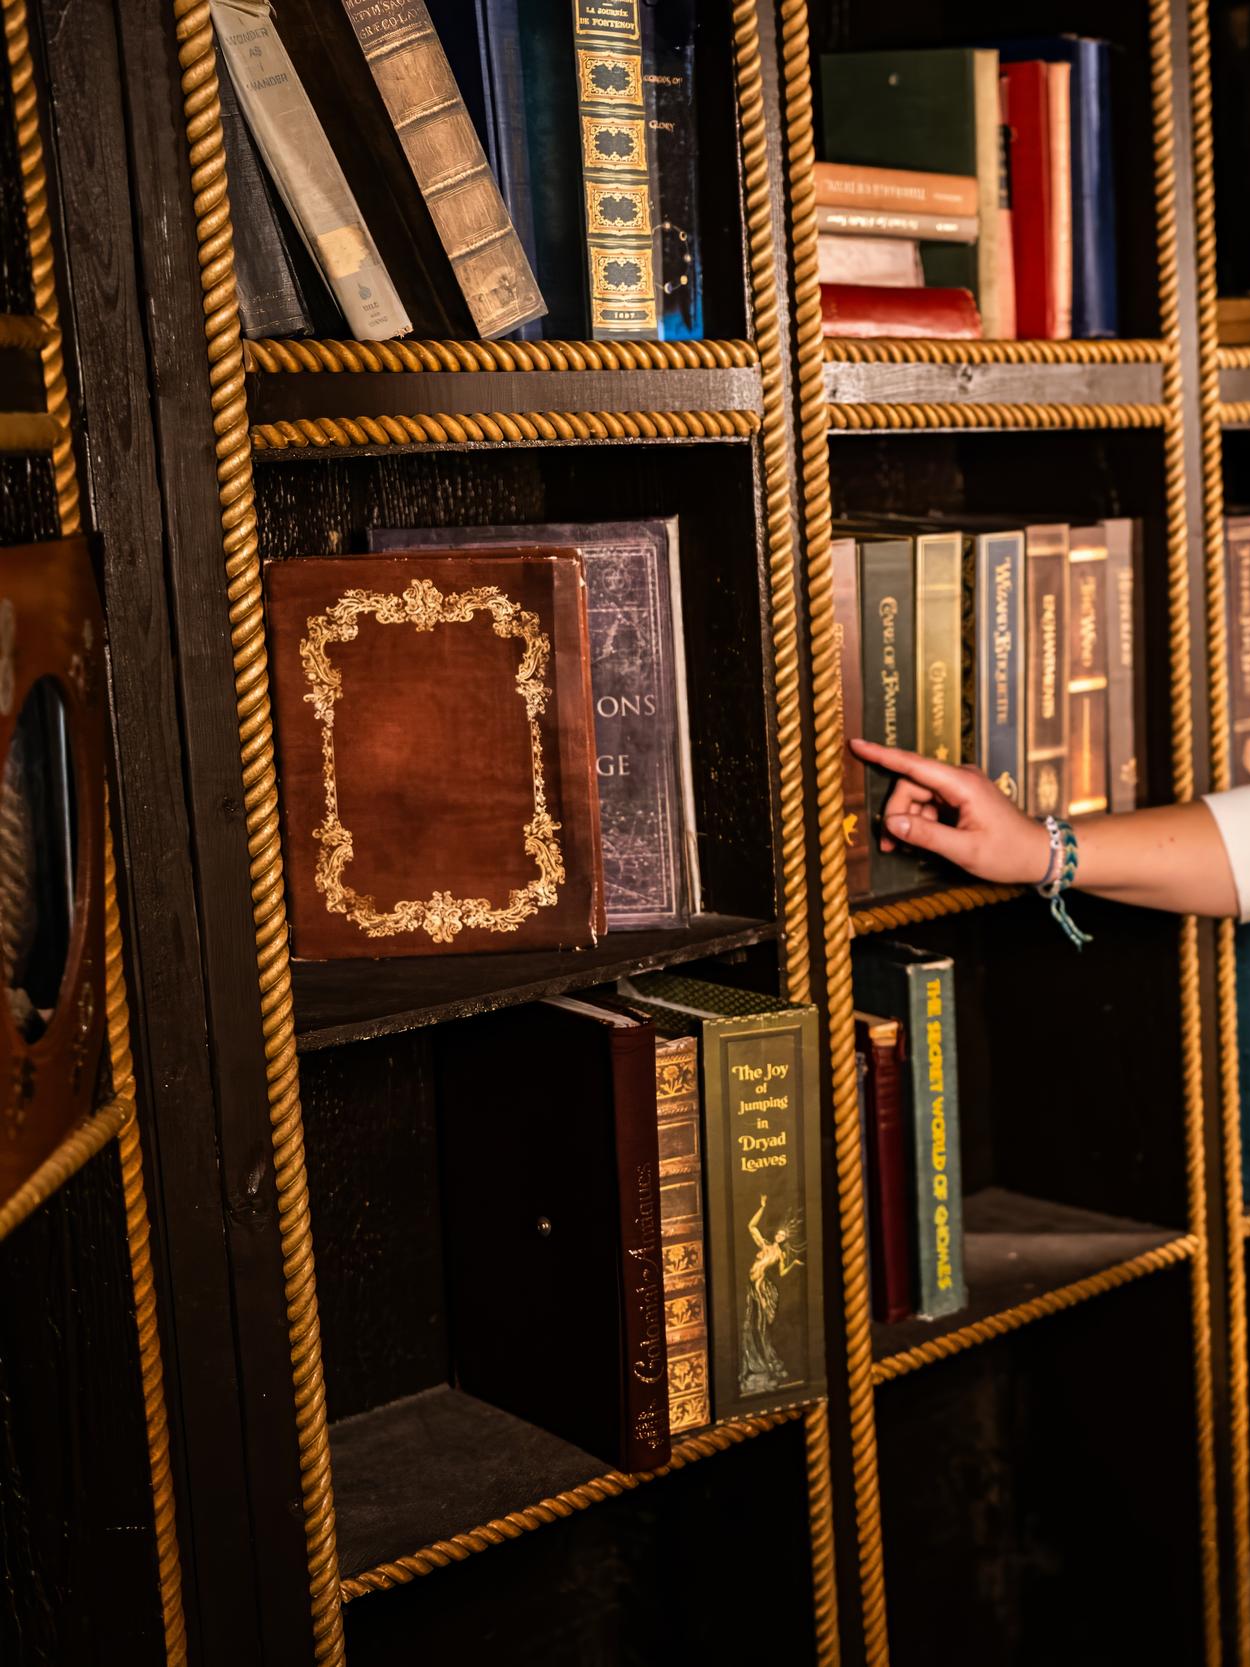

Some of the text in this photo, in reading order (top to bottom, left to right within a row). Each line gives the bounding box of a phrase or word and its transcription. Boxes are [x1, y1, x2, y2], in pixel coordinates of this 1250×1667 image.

[225, 27, 270, 46] WONDER
[248, 45, 263, 57] AS
[994, 556, 1012, 632] WIZARD
[879, 596, 898, 644] CARE
[884, 645, 896, 669] OF
[926, 978, 942, 1018] THE
[926, 1020, 944, 1092] SECRET
[731, 1063, 789, 1081] The Joy
[755, 1082, 768, 1094] of
[737, 1096, 789, 1115] Jumping
[756, 1118, 769, 1129] in
[931, 1096, 947, 1171] WORLD
[738, 1131, 787, 1152] Dryad
[741, 1154, 788, 1172] Leaves
[933, 1173, 949, 1201] OF
